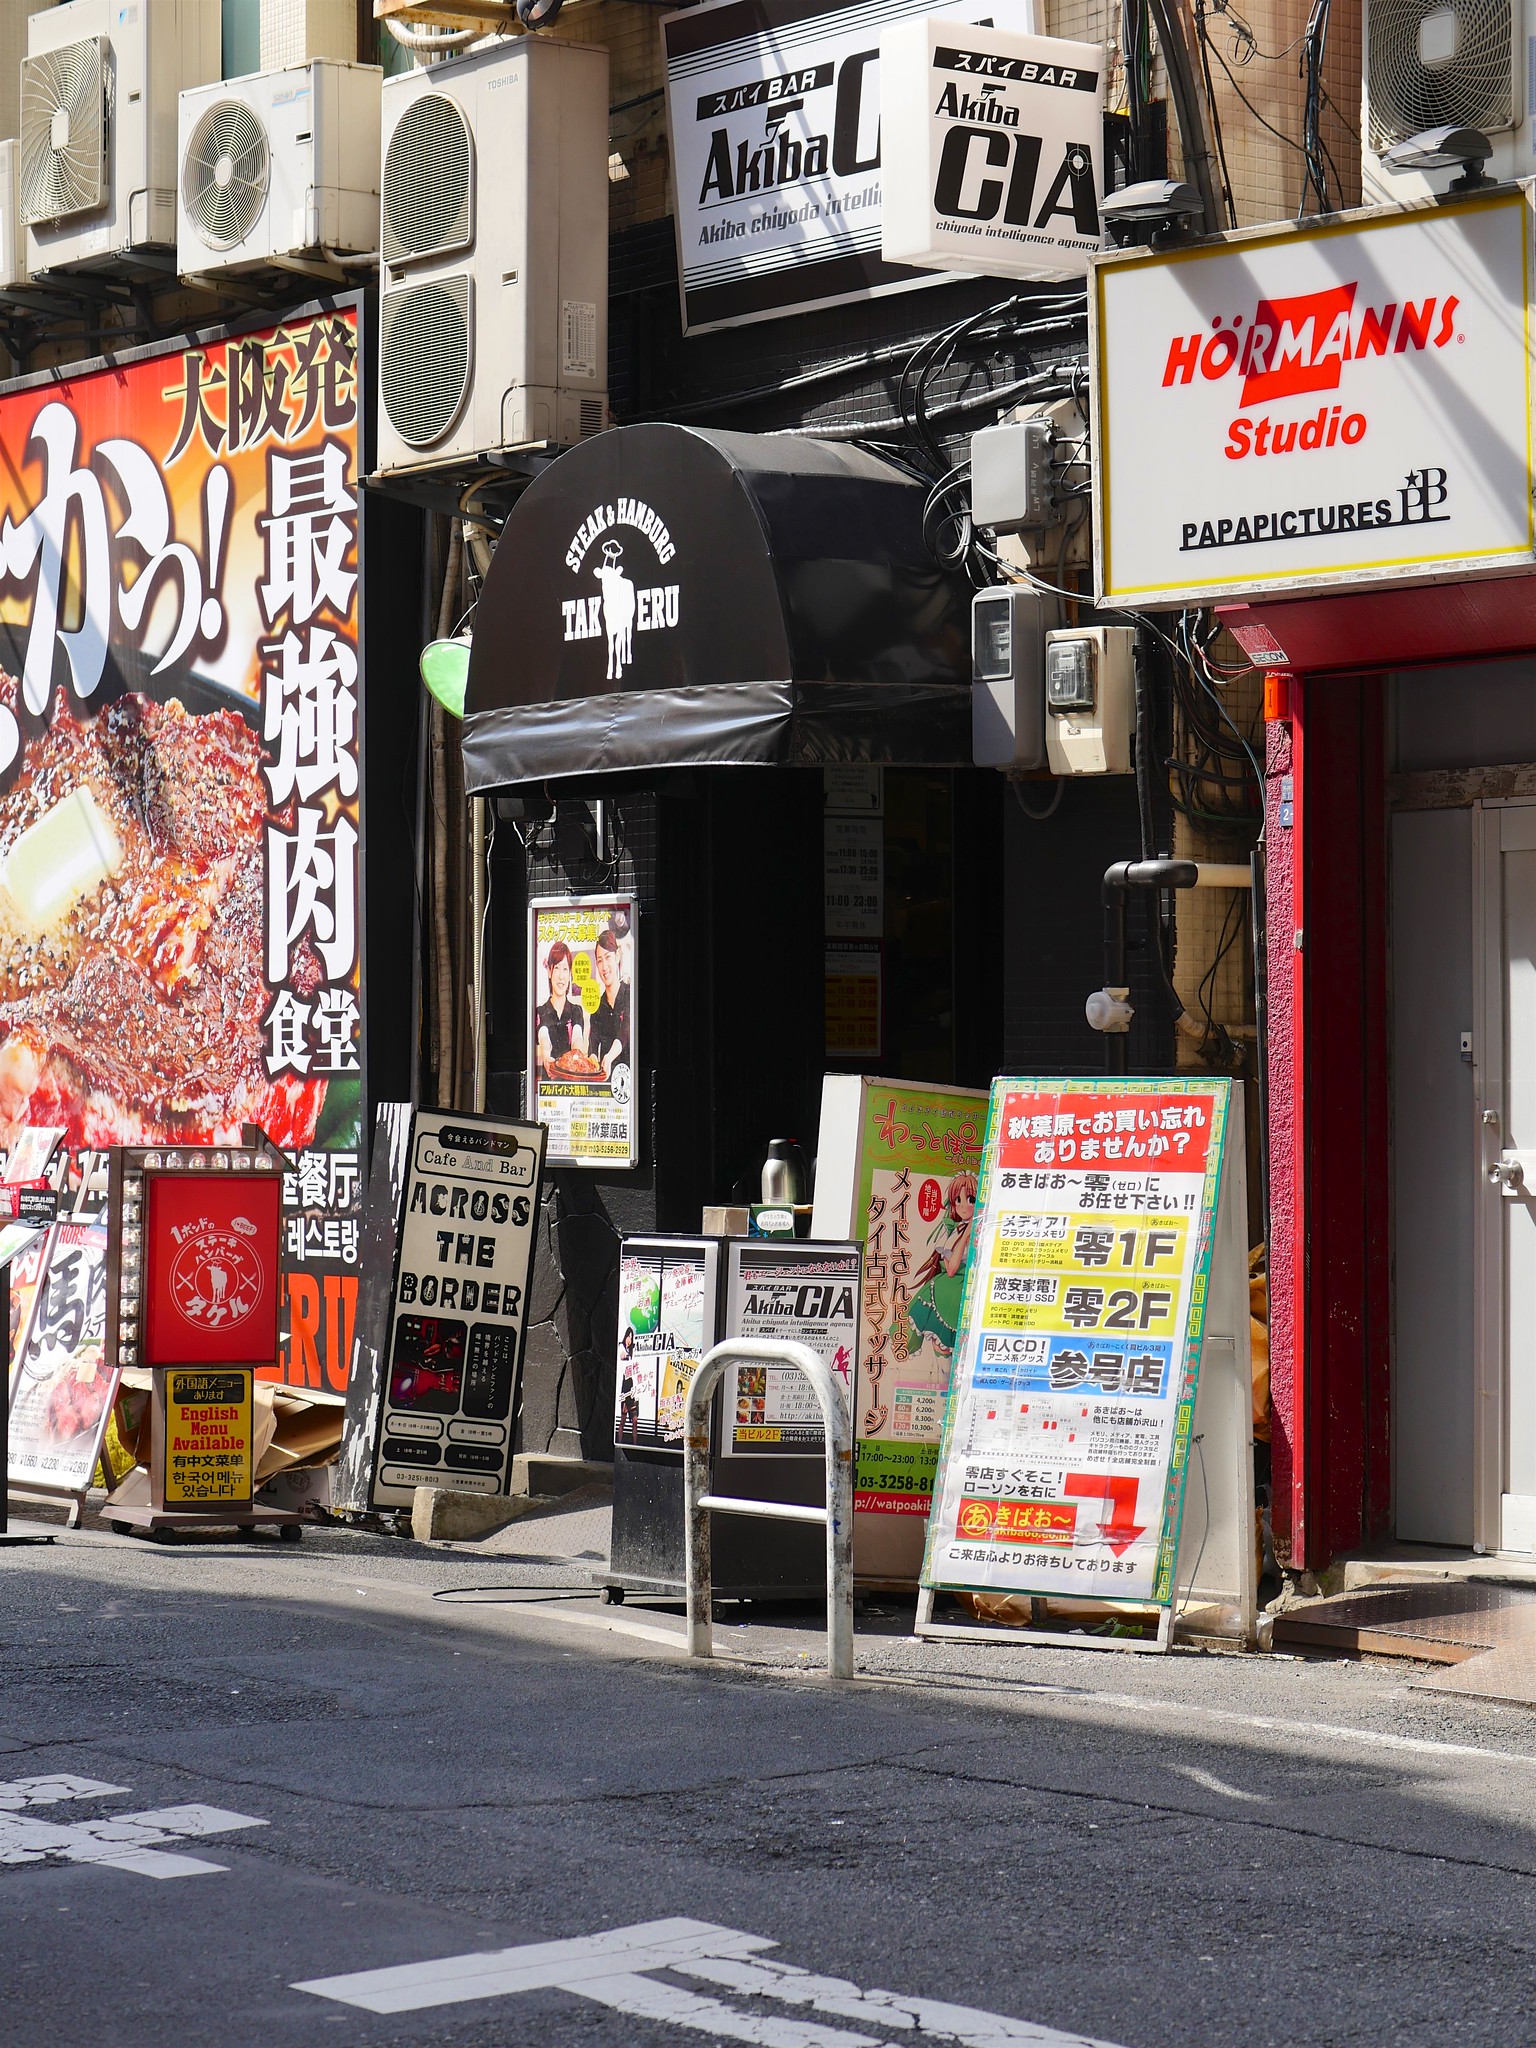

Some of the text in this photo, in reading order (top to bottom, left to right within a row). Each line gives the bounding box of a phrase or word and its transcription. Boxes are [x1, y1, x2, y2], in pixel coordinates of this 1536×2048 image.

[955, 52, 1078, 88] スパイ BAR
[488, 74, 518, 90] TOSHIBA
[713, 69, 817, 114] スパイ BAR
[935, 85, 1020, 127] Akiba
[699, 106, 829, 204] Akiba
[933, 125, 1101, 236] CIA
[698, 219, 746, 246] Akiba
[750, 204, 820, 233] chiyoda
[936, 220, 1100, 252] chiyoda intelligence agency
[1161, 296, 1460, 388] HÖRMANNS
[162, 316, 357, 466] 大阪発
[1224, 405, 1367, 461] Studio
[1181, 499, 1392, 548] PAPAPICTURES
[565, 497, 676, 574] STEAK & HAMBURG
[1252, 651, 1287, 663] SECOM
[591, 1121, 627, 1139] 秋葉原店
[1008, 1106, 1205, 1140] 秋葉原でお買い忘れ
[447, 1132, 510, 1149] 今会えるバンドマン
[1035, 1132, 1191, 1164] ありませんか？
[424, 1150, 526, 1176] Cafe And Bar
[409, 1181, 530, 1227] ACROSS
[922, 1184, 931, 1217] 地下1階
[930, 1190, 938, 1212] 当ビル
[170, 1217, 214, 1245] 1ポンドの
[1003, 1215, 1067, 1229] メディア!
[195, 1235, 238, 1251] ステーキ
[287, 1217, 359, 1265] 레스토랑
[1002, 1229, 1066, 1238] フラッシュメモリ
[195, 1246, 244, 1265] ハンバーグ
[437, 1230, 496, 1268] THE
[1073, 1226, 1178, 1268] 零1F
[889, 1167, 911, 1362] メイドさんによる
[399, 1272, 522, 1317] BORDER
[993, 1277, 1057, 1293] 激安家電!
[684, 1300, 702, 1311] メニュー
[743, 1285, 853, 1319] Akiba CIA
[1035, 1293, 1055, 1302] SSD
[1064, 1287, 1172, 1329] 零2F
[185, 1295, 249, 1326] タケル
[864, 1195, 889, 1438] タイ古式マッサージ
[790, 1319, 828, 1327] intelligence
[653, 1332, 675, 1351] CIA
[985, 1338, 1046, 1353] 同人CD!
[987, 1353, 1044, 1363] アニメ系グッズ
[625, 1362, 640, 1378] 個性
[781, 1372, 809, 1381] (03)32
[1050, 1351, 1164, 1394] 参号店
[176, 1377, 243, 1390] 外国語メニュー
[193, 1390, 225, 1400] あります
[181, 1407, 239, 1421] English
[780, 1412, 824, 1420] http://akiba
[1093, 1416, 1164, 1427] 他にも店舗が沢山!
[1094, 1406, 1142, 1416] あきばお〜は
[191, 1422, 228, 1435] Menu
[739, 1429, 780, 1440] 当ビル2F
[173, 1436, 244, 1450] Available
[173, 1454, 244, 1467] 有中文菜单
[965, 1466, 1063, 1484] 零店すぐそこ!
[182, 1483, 236, 1498] 있습니다
[964, 1482, 1056, 1498] ローソンを右に
[961, 1502, 1071, 1536] あきばお〜
[949, 1549, 1137, 1574] ご来店心よりお待ちしております
